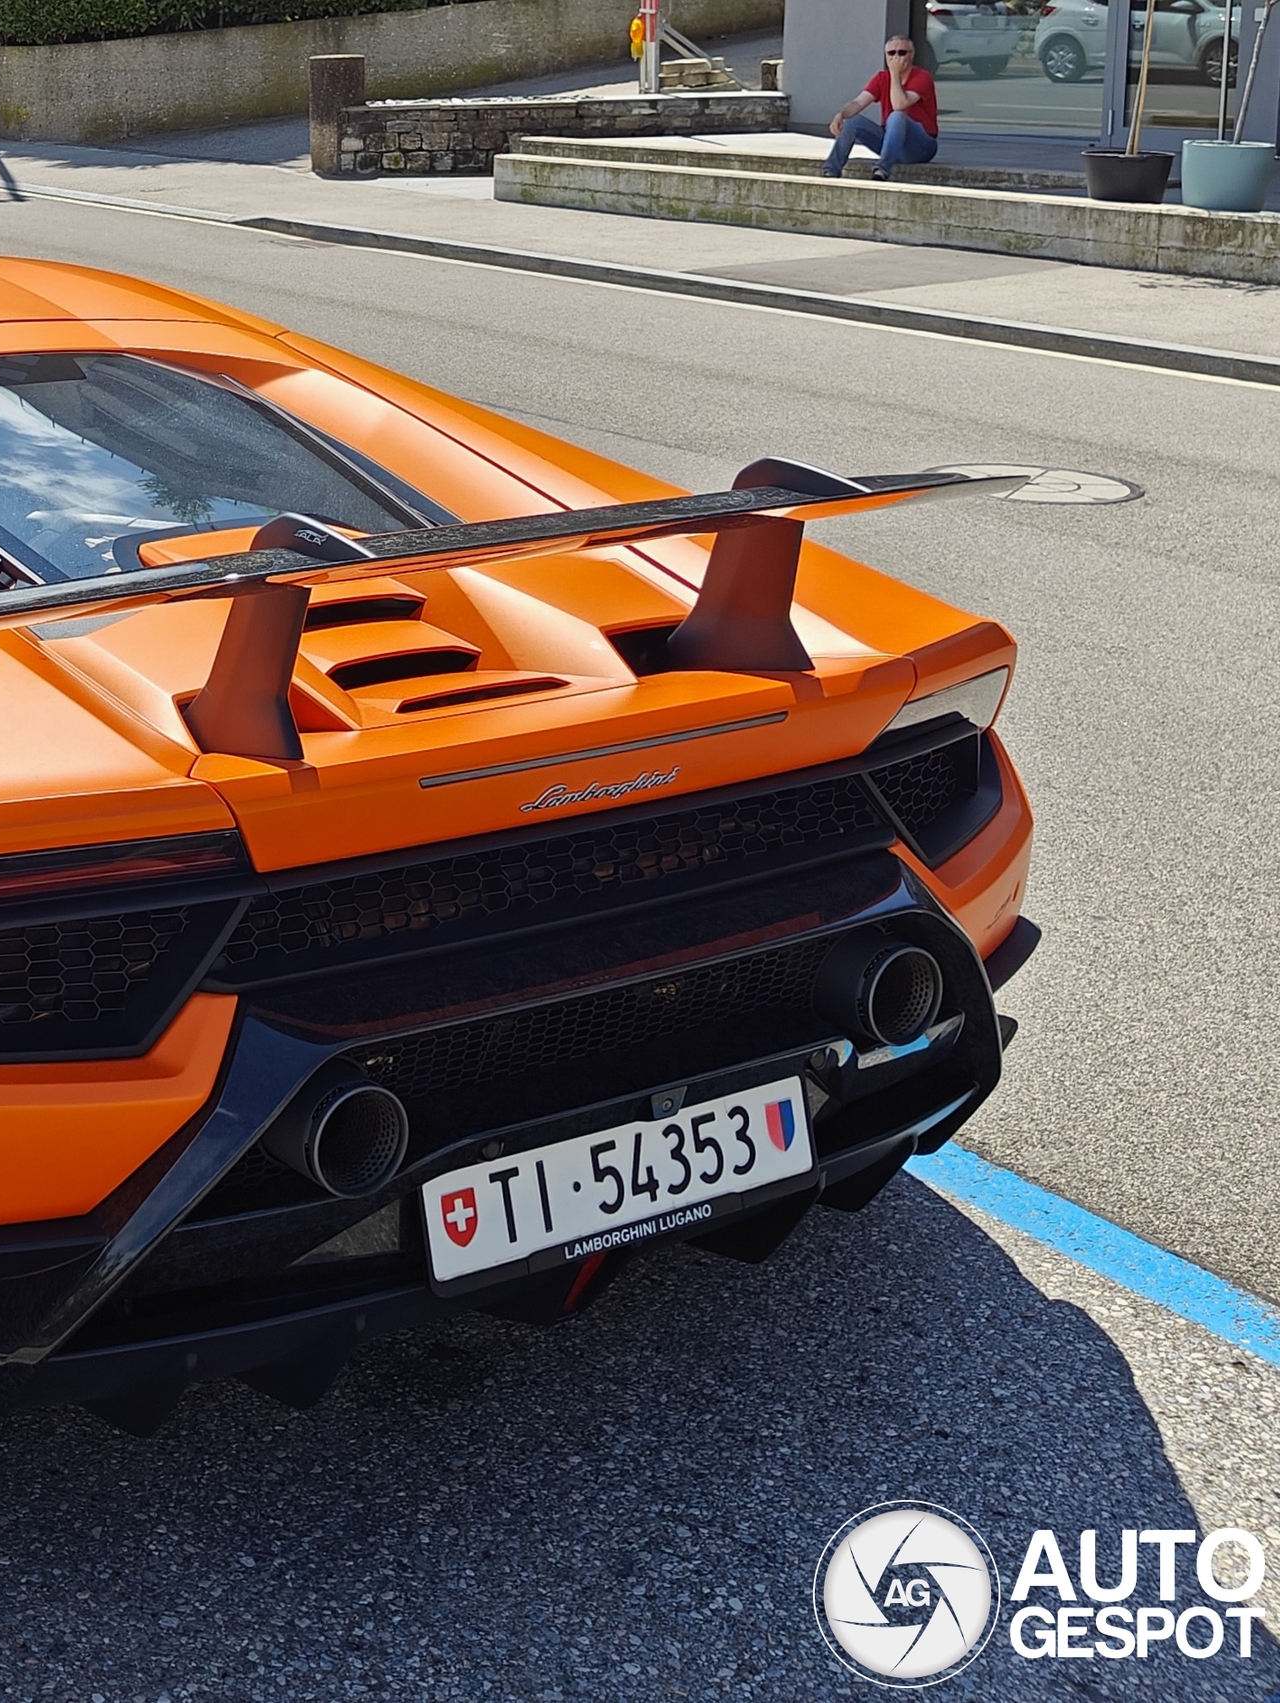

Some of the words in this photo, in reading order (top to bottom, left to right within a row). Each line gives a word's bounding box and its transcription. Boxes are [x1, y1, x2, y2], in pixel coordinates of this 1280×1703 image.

[519, 766, 681, 812] Lamborghini
[564, 1220, 658, 1260] LAMBORGHINI
[659, 1203, 712, 1232] LUGANO
